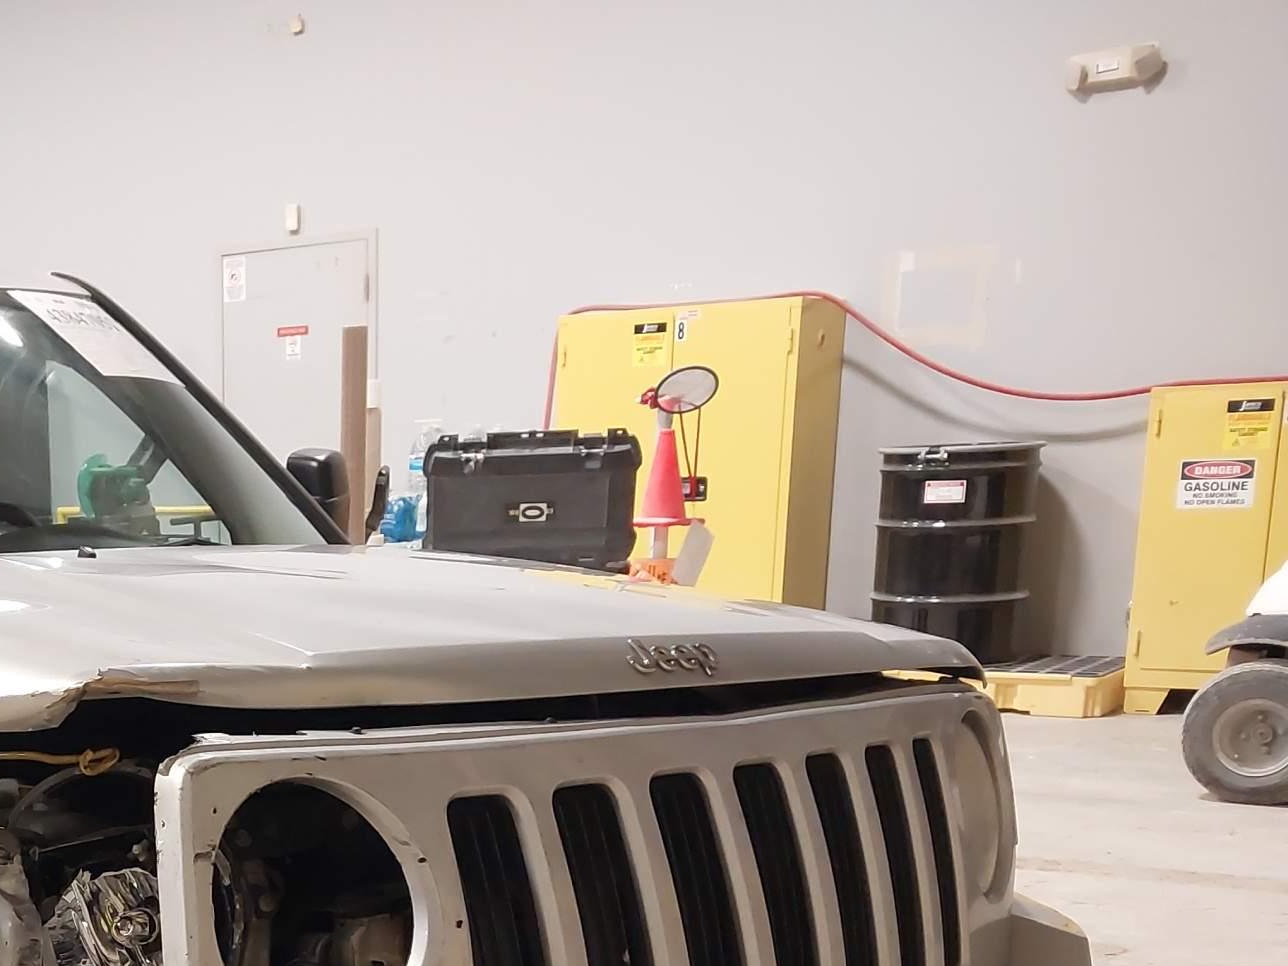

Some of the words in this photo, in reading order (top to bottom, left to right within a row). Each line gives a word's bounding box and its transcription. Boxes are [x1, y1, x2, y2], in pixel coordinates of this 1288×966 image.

[677, 322, 685, 340] 8
[1194, 465, 1242, 475] DANGER
[1184, 481, 1249, 492] GASOLINE
[626, 638, 718, 676] Jeep
